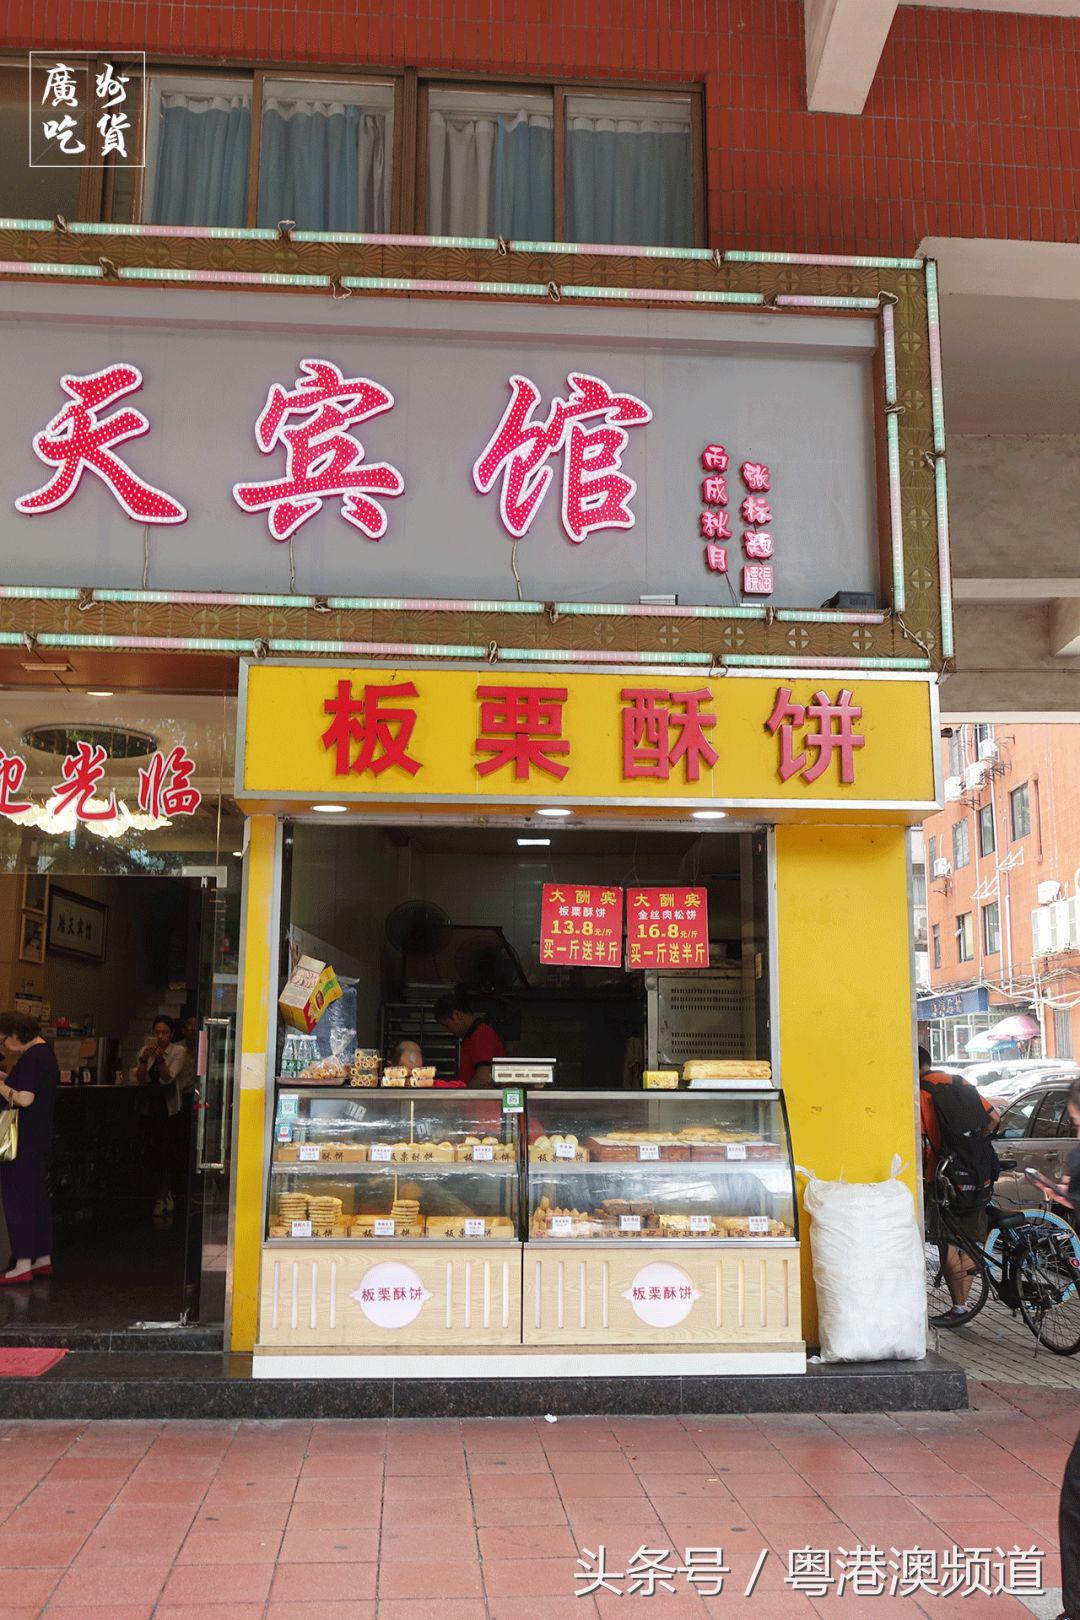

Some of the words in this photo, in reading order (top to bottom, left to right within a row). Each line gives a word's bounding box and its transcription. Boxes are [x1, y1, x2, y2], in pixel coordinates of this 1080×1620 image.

[15, 359, 652, 543] 天宾馆
[321, 679, 864, 786] 板栗酥饼
[549, 888, 617, 906] 大酬宾
[633, 893, 701, 908] 大酬宾
[558, 905, 607, 918] 板栗酥饼
[638, 909, 697, 921] 金丝肉松饼
[543, 938, 619, 962] 买一斤送半斤
[631, 942, 705, 965] 买一斤送半斤
[361, 1286, 423, 1303] 板栗酥饼
[632, 1285, 693, 1301] 板栗酥饼
